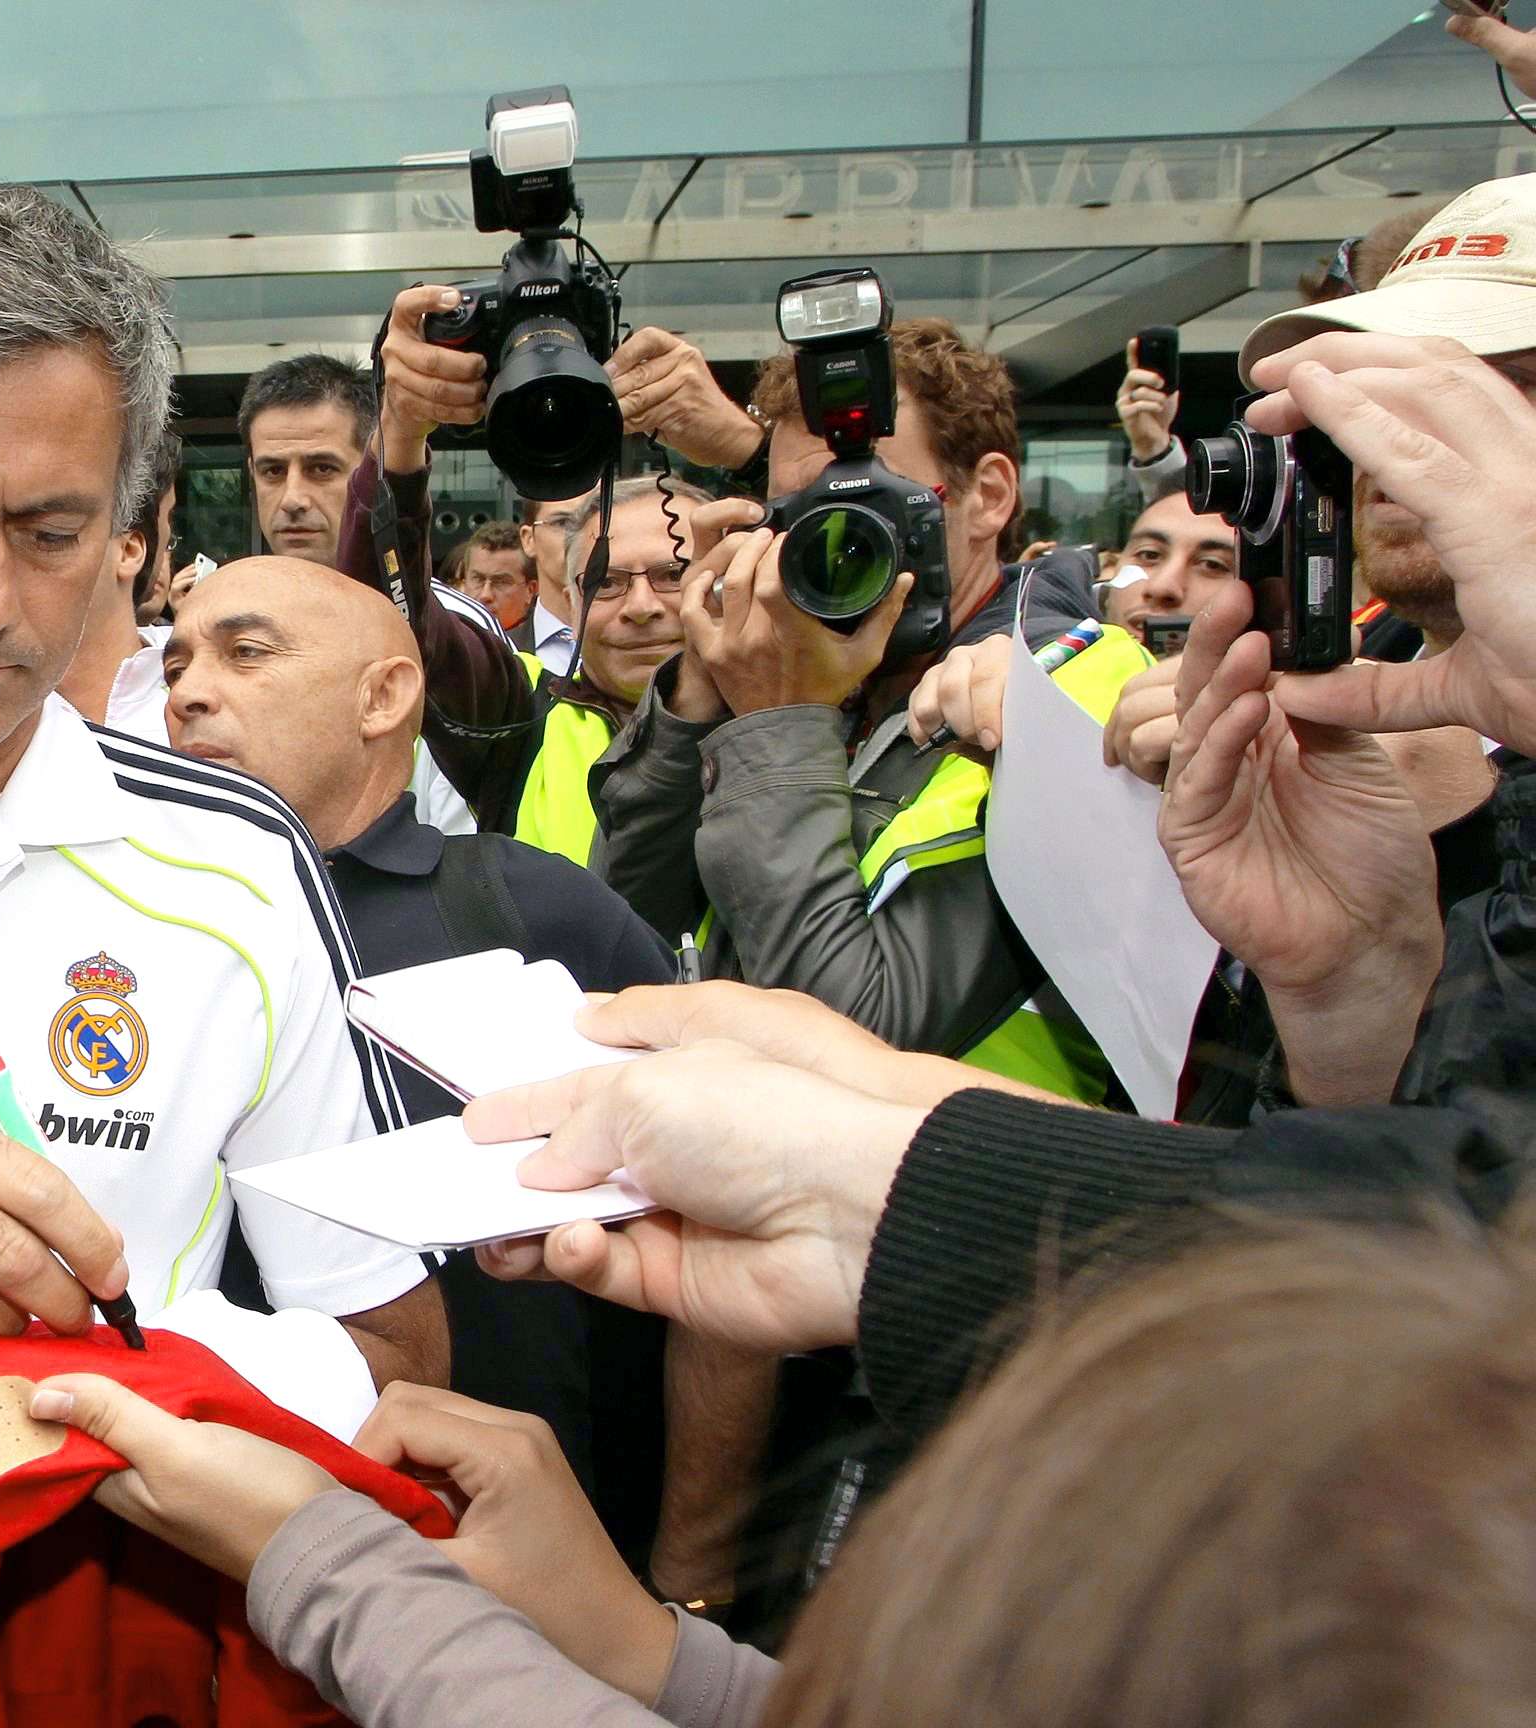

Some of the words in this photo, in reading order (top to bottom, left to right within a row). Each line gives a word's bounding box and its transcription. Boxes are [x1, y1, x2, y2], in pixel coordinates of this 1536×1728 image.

[520, 284, 560, 297] Nikon
[826, 360, 856, 370] Canon
[828, 478, 871, 491] Canon
[39, 1103, 151, 1151] bwin
